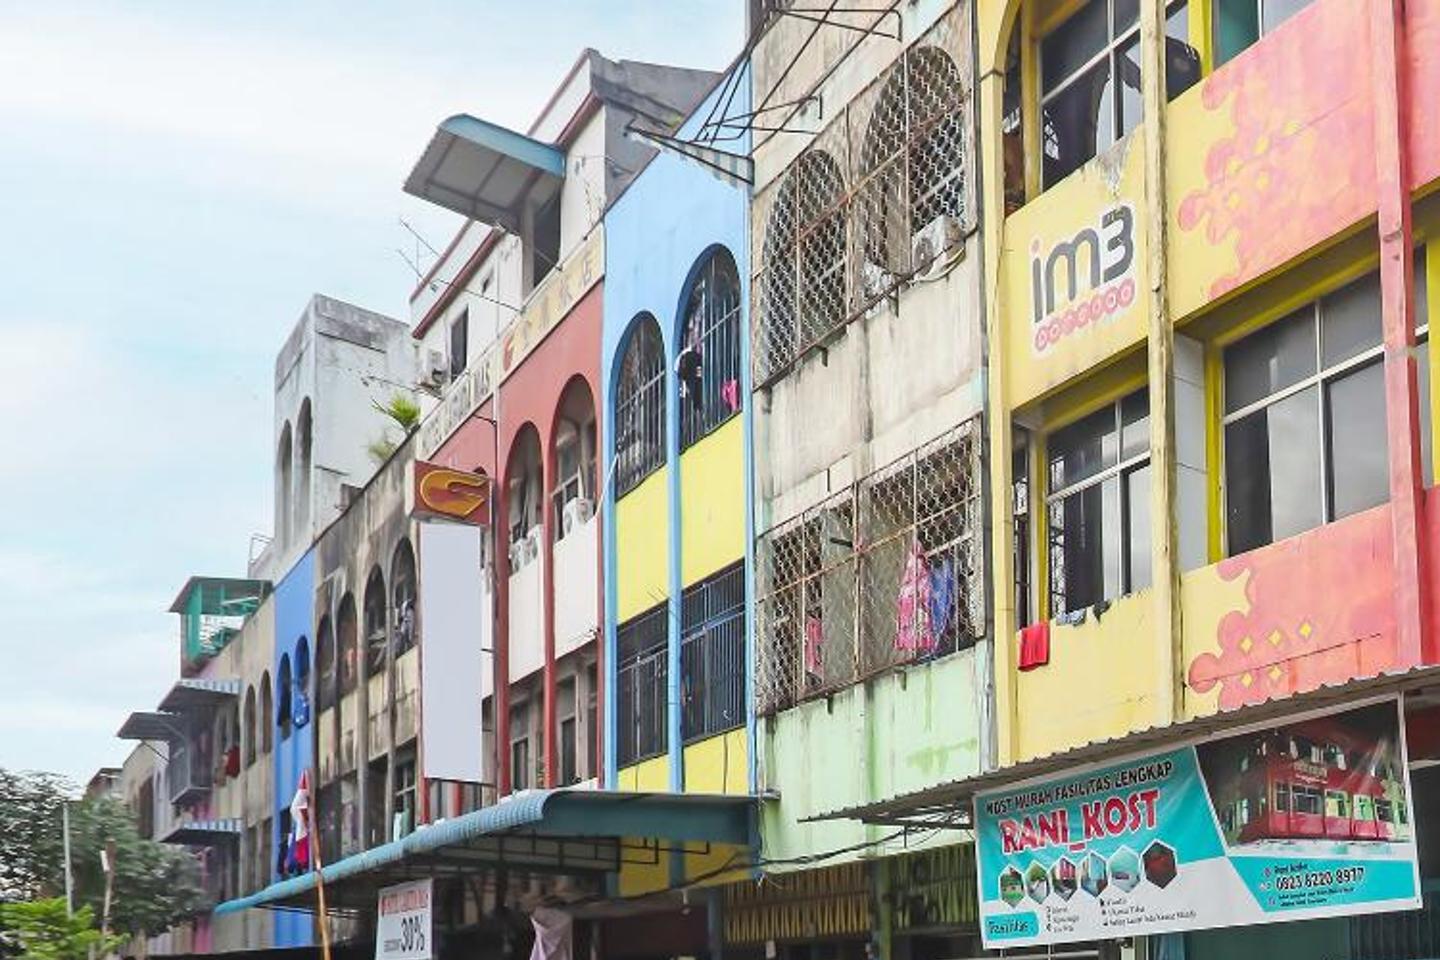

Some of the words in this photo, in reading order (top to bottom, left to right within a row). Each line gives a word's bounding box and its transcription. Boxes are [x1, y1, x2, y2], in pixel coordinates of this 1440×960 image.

[1031, 205, 1134, 323] im3
[986, 799, 1012, 815] KOST
[1015, 792, 1054, 809] MURAH
[1055, 775, 1112, 801] FASILITAS
[1114, 760, 1173, 789] LENGKAP
